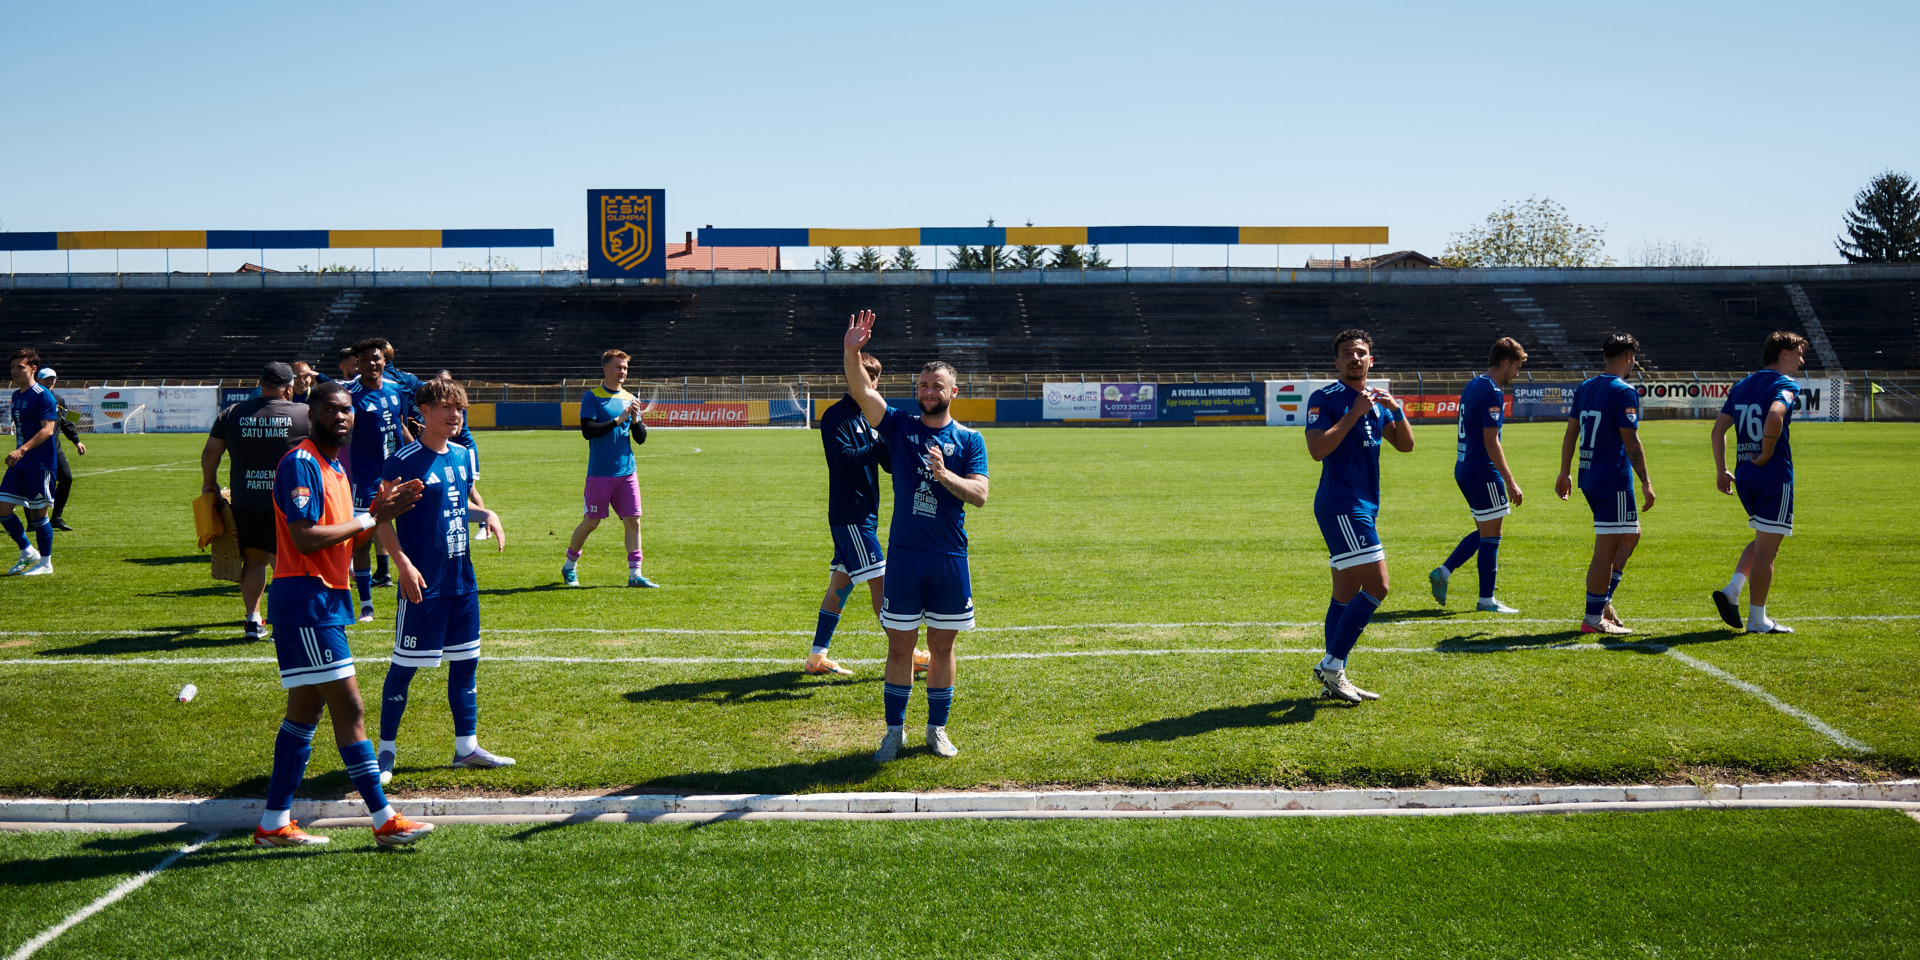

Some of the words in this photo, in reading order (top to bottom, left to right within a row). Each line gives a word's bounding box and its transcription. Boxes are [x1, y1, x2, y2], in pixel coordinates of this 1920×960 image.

[607, 205, 646, 214] CSM
[158, 389, 198, 399] M-SYS
[1171, 389, 1177, 397] A
[1178, 388, 1207, 397] FUTBALL
[1208, 386, 1251, 396] MINDENKIÉ!
[1515, 388, 1544, 397] SPUNE
[1561, 388, 1576, 397] RA
[1063, 394, 1098, 402] Medima
[1166, 399, 1178, 407] Egy
[1178, 398, 1200, 406] csapat,
[1233, 398, 1244, 406] egy
[1405, 402, 1435, 411] casa
[643, 410, 667, 419] asa
[669, 408, 743, 422] pariurilor
[239, 417, 257, 426] CSM
[259, 417, 293, 427] OLIMPIA
[1734, 403, 1763, 442] 76
[380, 424, 397, 432] M-SYS
[242, 428, 262, 438] SATU
[265, 428, 289, 438] MARE
[1737, 442, 1761, 451] CADEMIA
[246, 470, 276, 479] ACADEM
[247, 481, 274, 490] PARTIU
[354, 497, 363, 506] 21
[1500, 495, 1506, 504] 6
[443, 508, 466, 517] M-SYS
[589, 505, 598, 513] 33
[1627, 511, 1636, 520] 67
[1360, 535, 1367, 546] 2
[870, 552, 877, 562] 5
[403, 635, 417, 648] 86
[324, 649, 333, 662] 9
